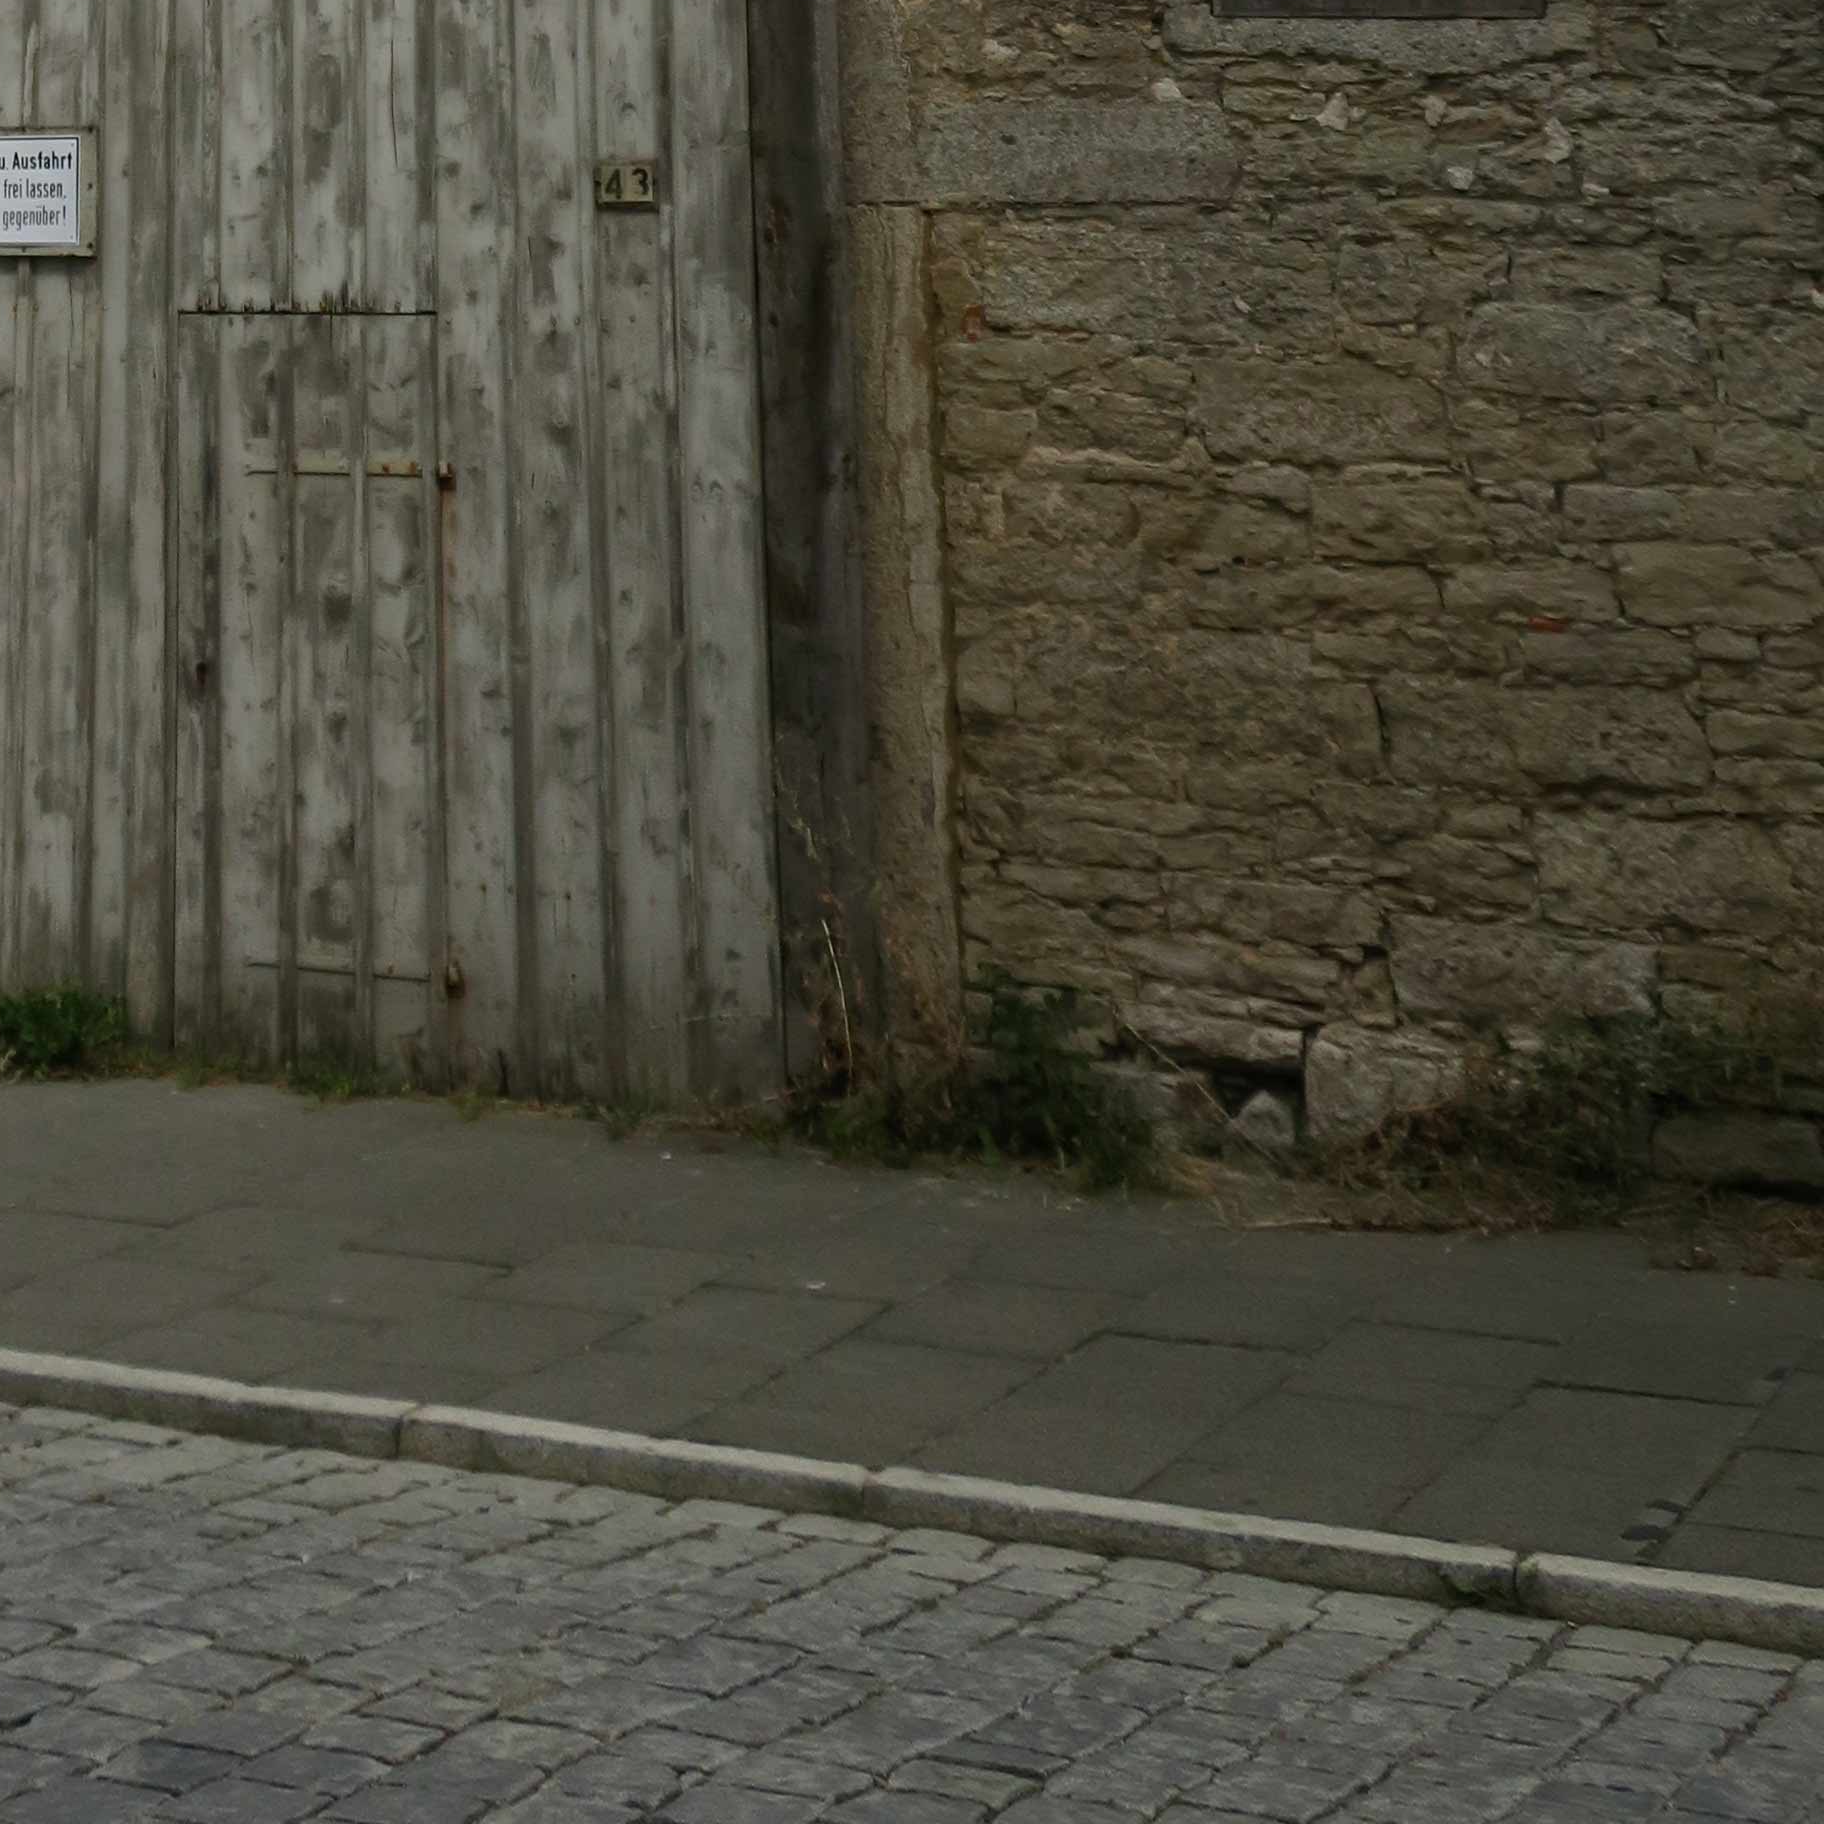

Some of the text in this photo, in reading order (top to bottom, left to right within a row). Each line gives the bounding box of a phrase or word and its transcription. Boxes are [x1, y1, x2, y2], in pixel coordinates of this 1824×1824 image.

[12, 151, 73, 170] Ausfahrt
[4, 179, 23, 199] frei
[605, 167, 650, 200] 43
